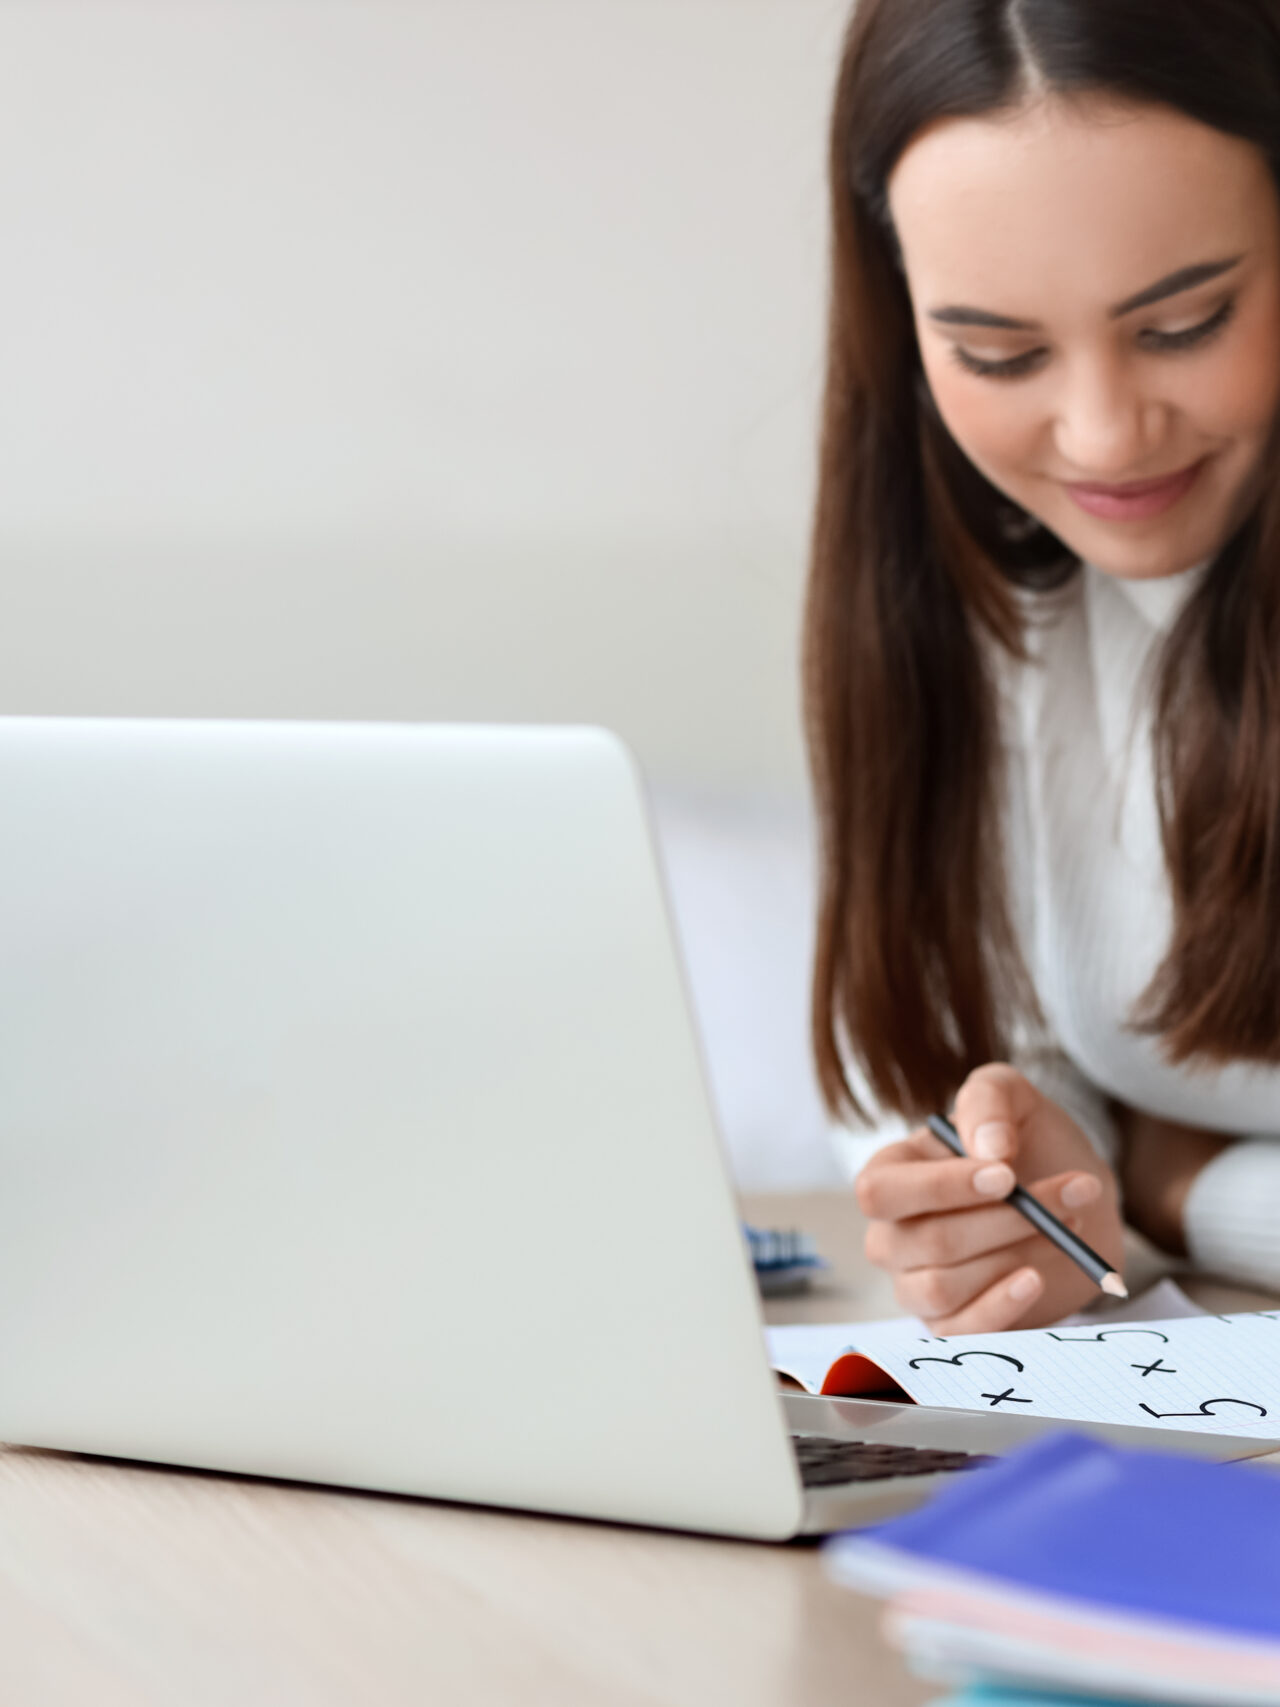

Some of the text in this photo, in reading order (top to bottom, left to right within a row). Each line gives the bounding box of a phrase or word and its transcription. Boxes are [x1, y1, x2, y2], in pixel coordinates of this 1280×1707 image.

[1046, 1329, 1170, 1344] 5
[908, 1351, 1025, 1373] 3
[1137, 1398, 1268, 1419] 5
